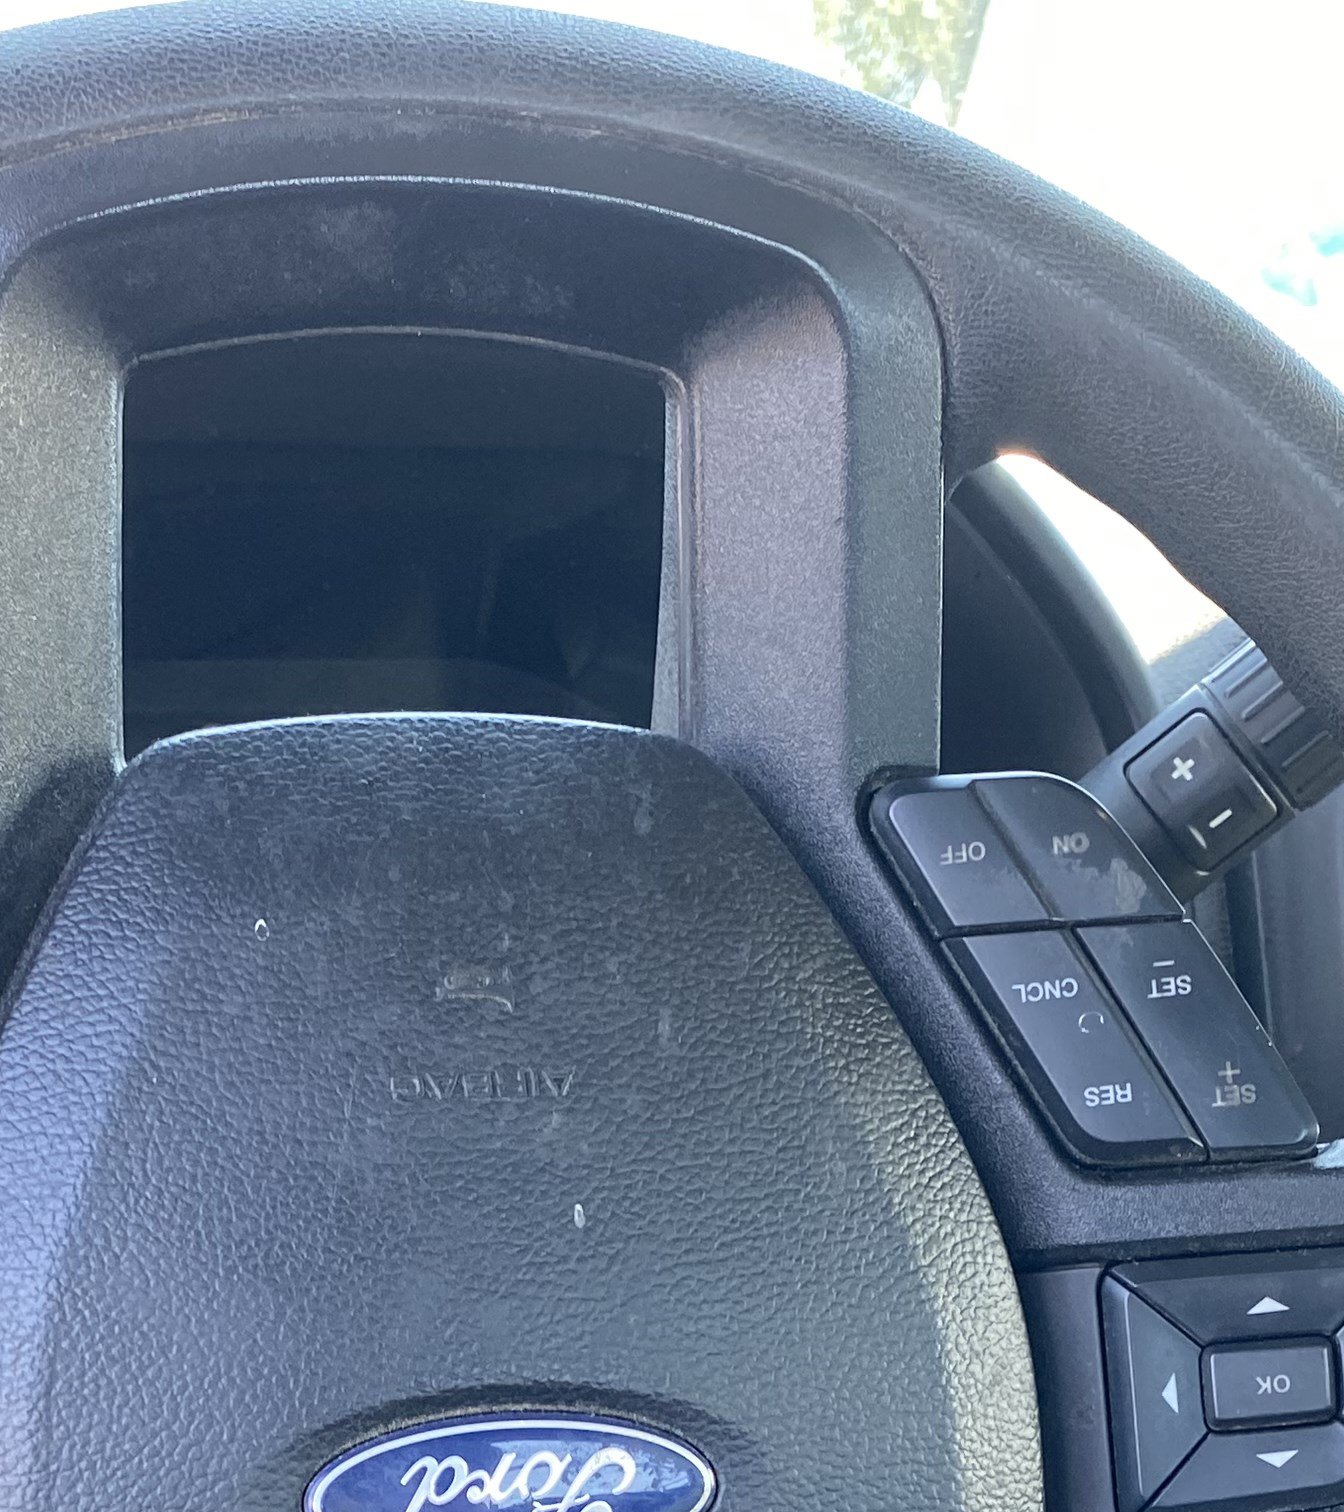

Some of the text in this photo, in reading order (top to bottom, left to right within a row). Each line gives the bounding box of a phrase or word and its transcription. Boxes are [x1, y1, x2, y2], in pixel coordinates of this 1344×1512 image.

[940, 841, 986, 866] OFF
[1052, 832, 1090, 856] ON
[1011, 977, 1079, 1004] CNCL
[1147, 974, 1192, 999] SET
[390, 1066, 577, 1101] AIRBAG
[1084, 1081, 1133, 1107] RES
[1212, 1083, 1256, 1108] SET
[1255, 1374, 1291, 1395] OK
